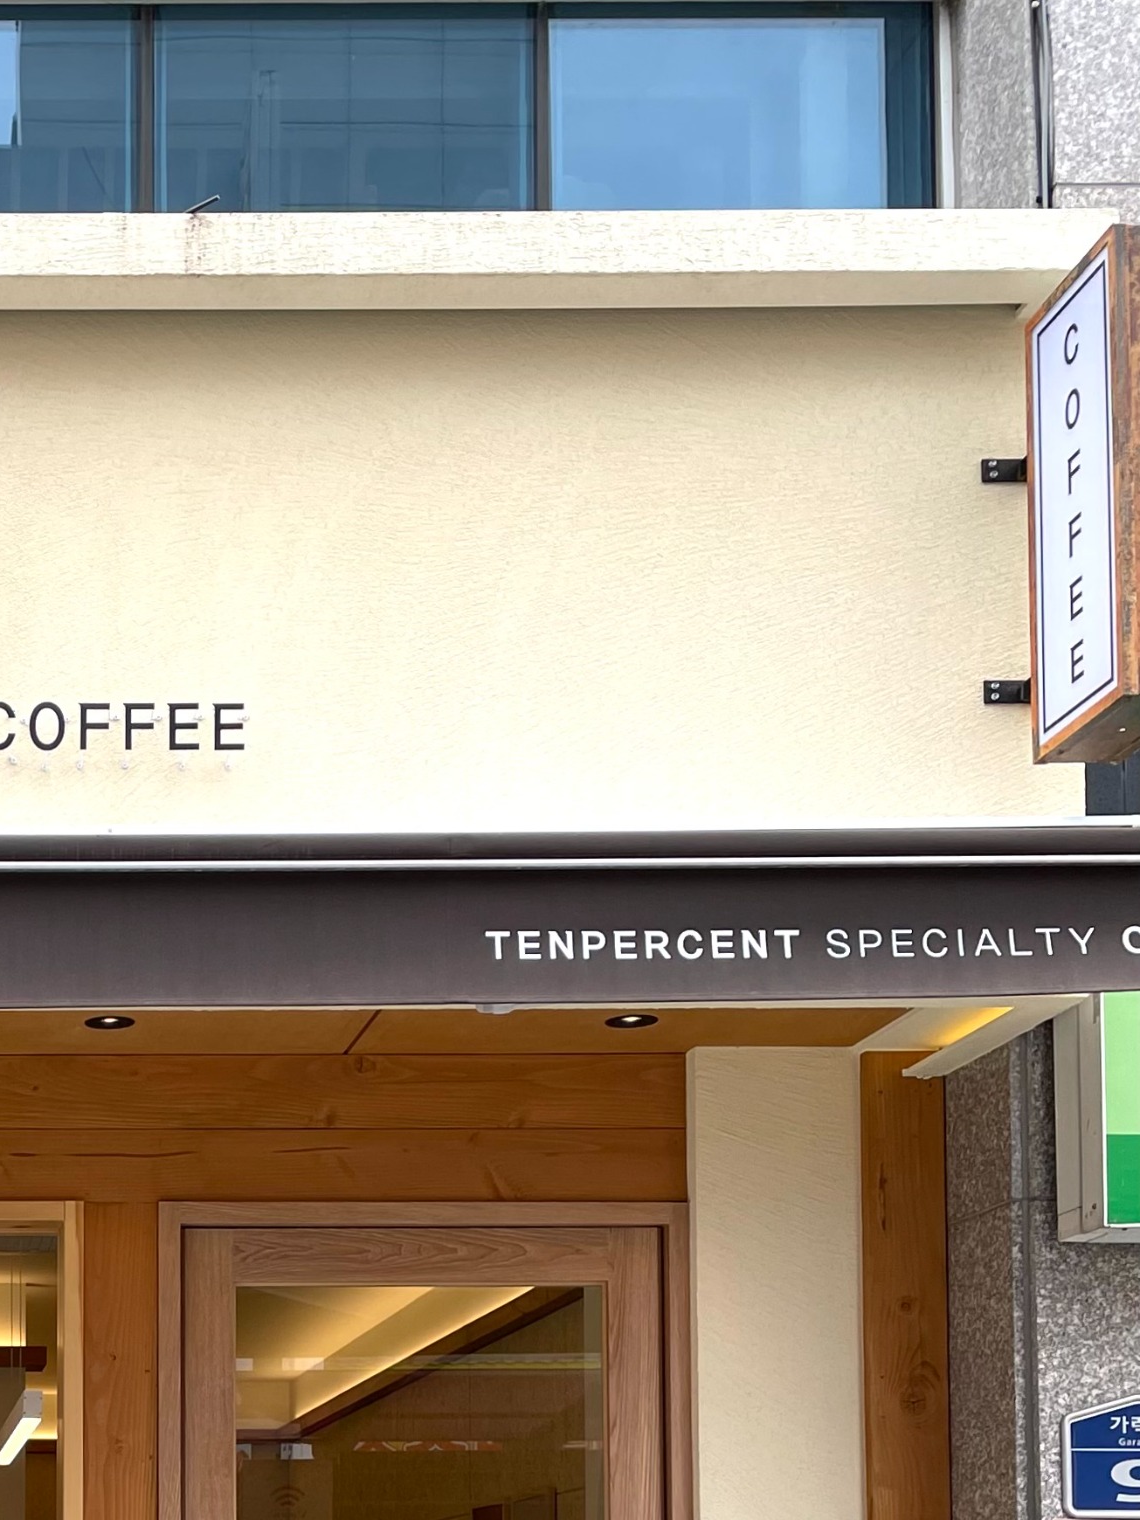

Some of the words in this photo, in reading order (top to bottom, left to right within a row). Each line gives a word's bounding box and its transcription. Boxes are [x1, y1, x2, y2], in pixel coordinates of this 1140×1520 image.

[1062, 323, 1085, 685] COFFEE
[485, 929, 800, 961] TENPERCENT
[826, 926, 1096, 958] SPECIALTY
